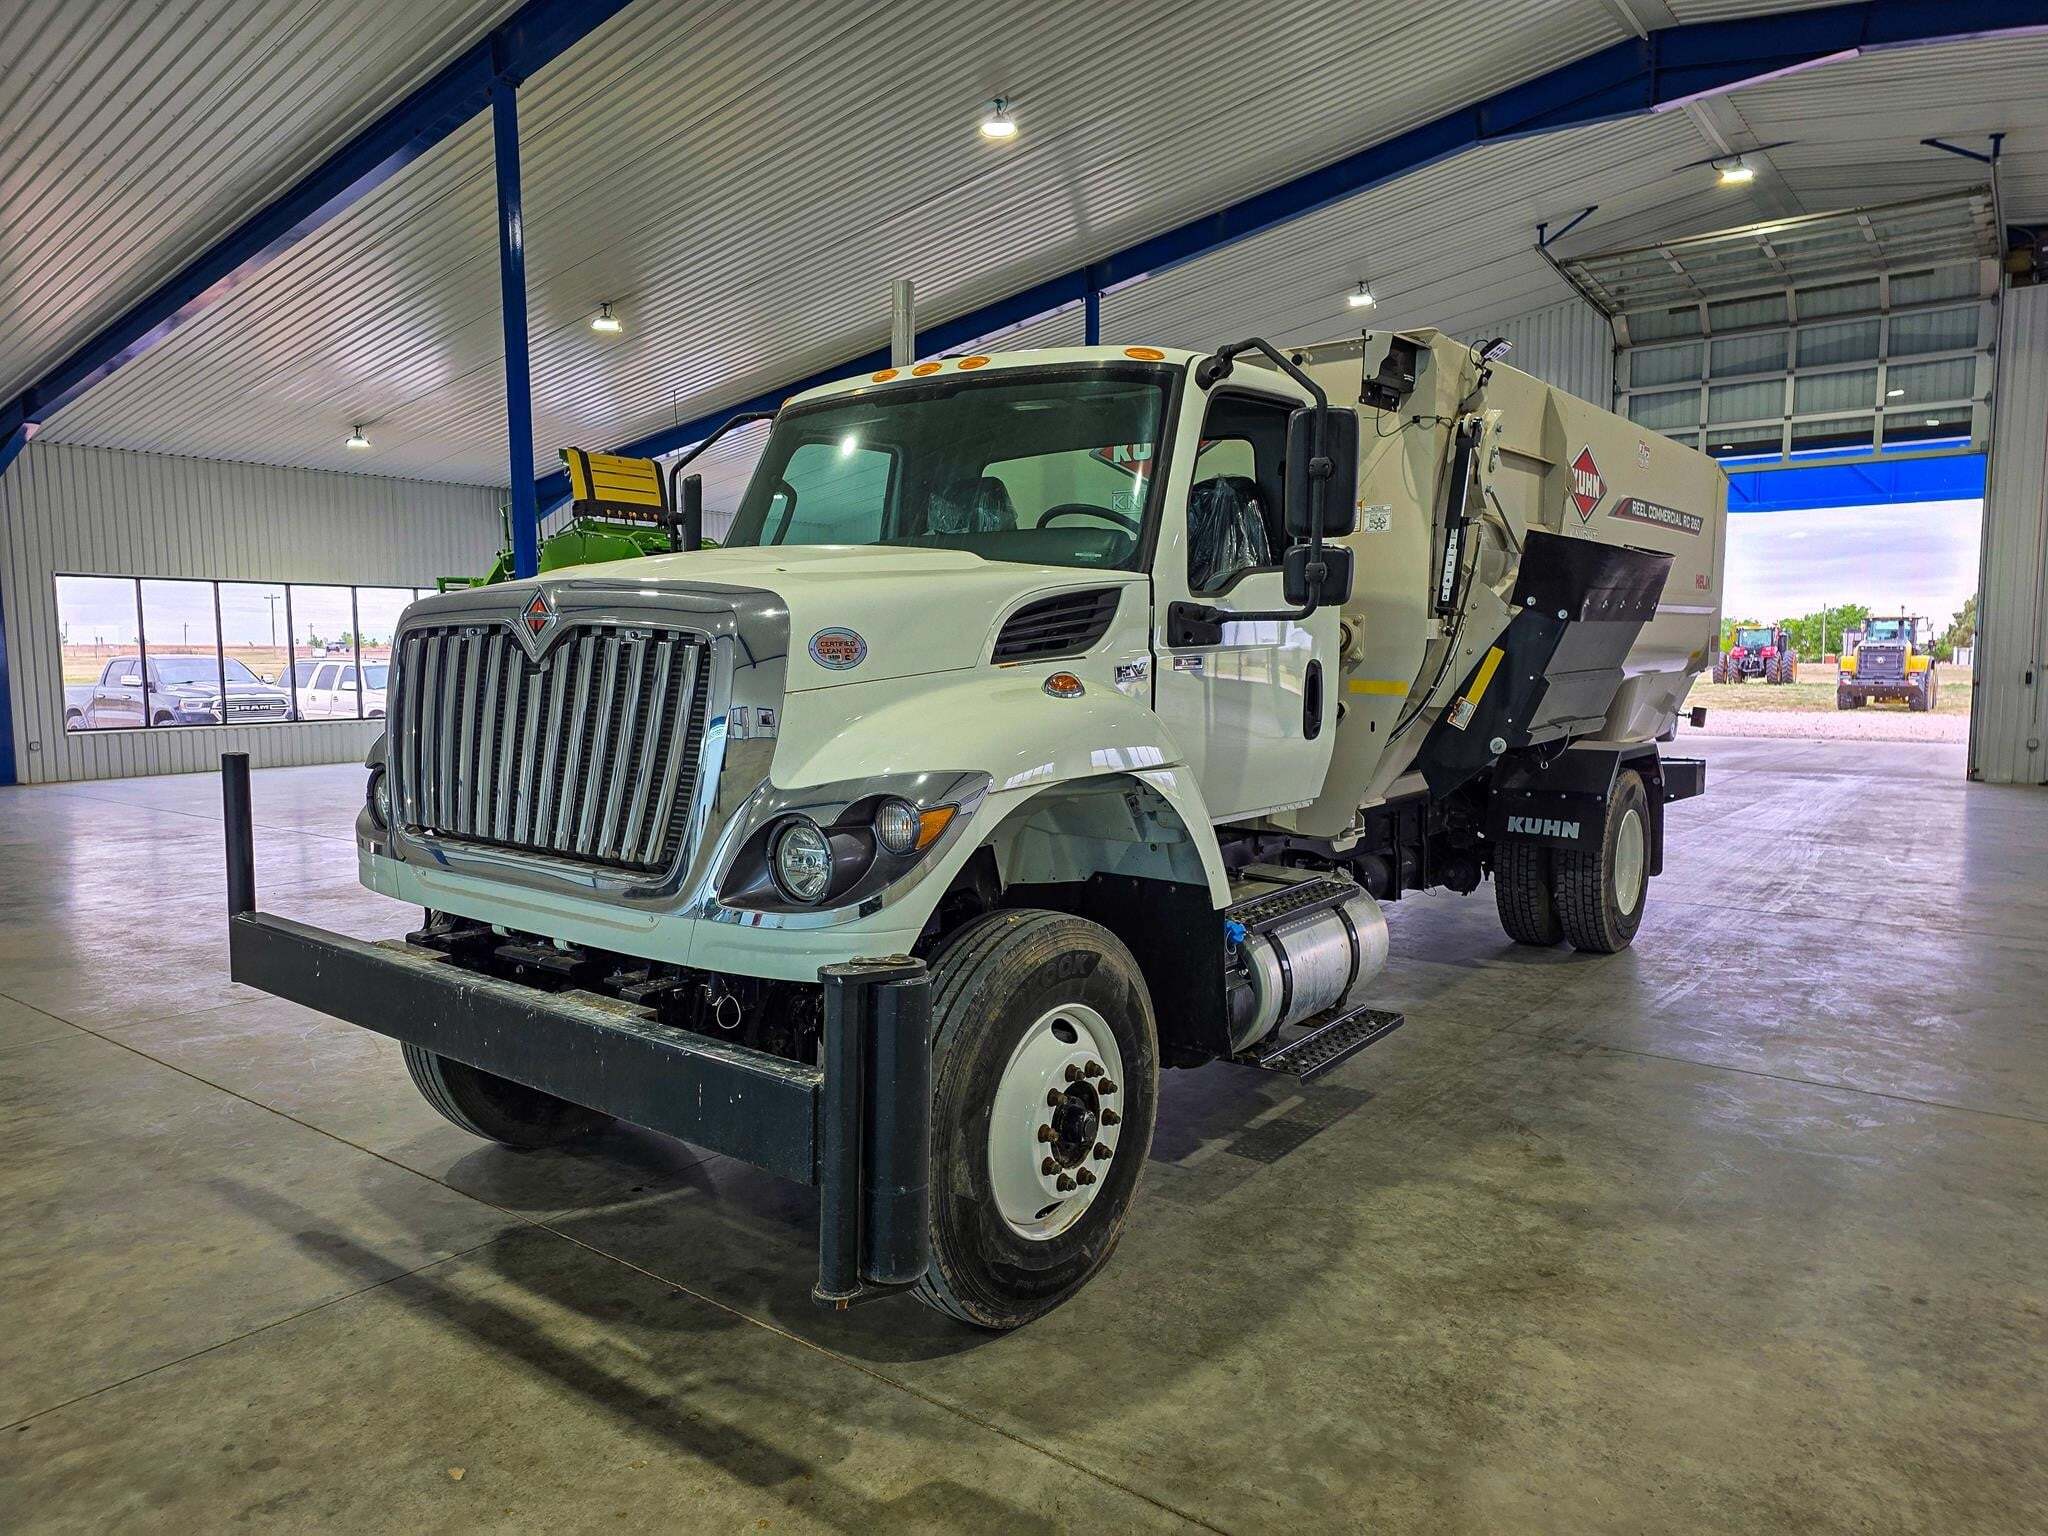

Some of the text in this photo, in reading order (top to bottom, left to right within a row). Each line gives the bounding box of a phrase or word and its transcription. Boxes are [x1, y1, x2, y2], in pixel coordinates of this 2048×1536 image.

[1113, 444, 1152, 463] KU
[1632, 500, 1648, 518] REEL
[1648, 505, 1682, 526] COMMERCIAL
[1115, 662, 1148, 678] HV
[1507, 815, 1580, 839] KUHN
